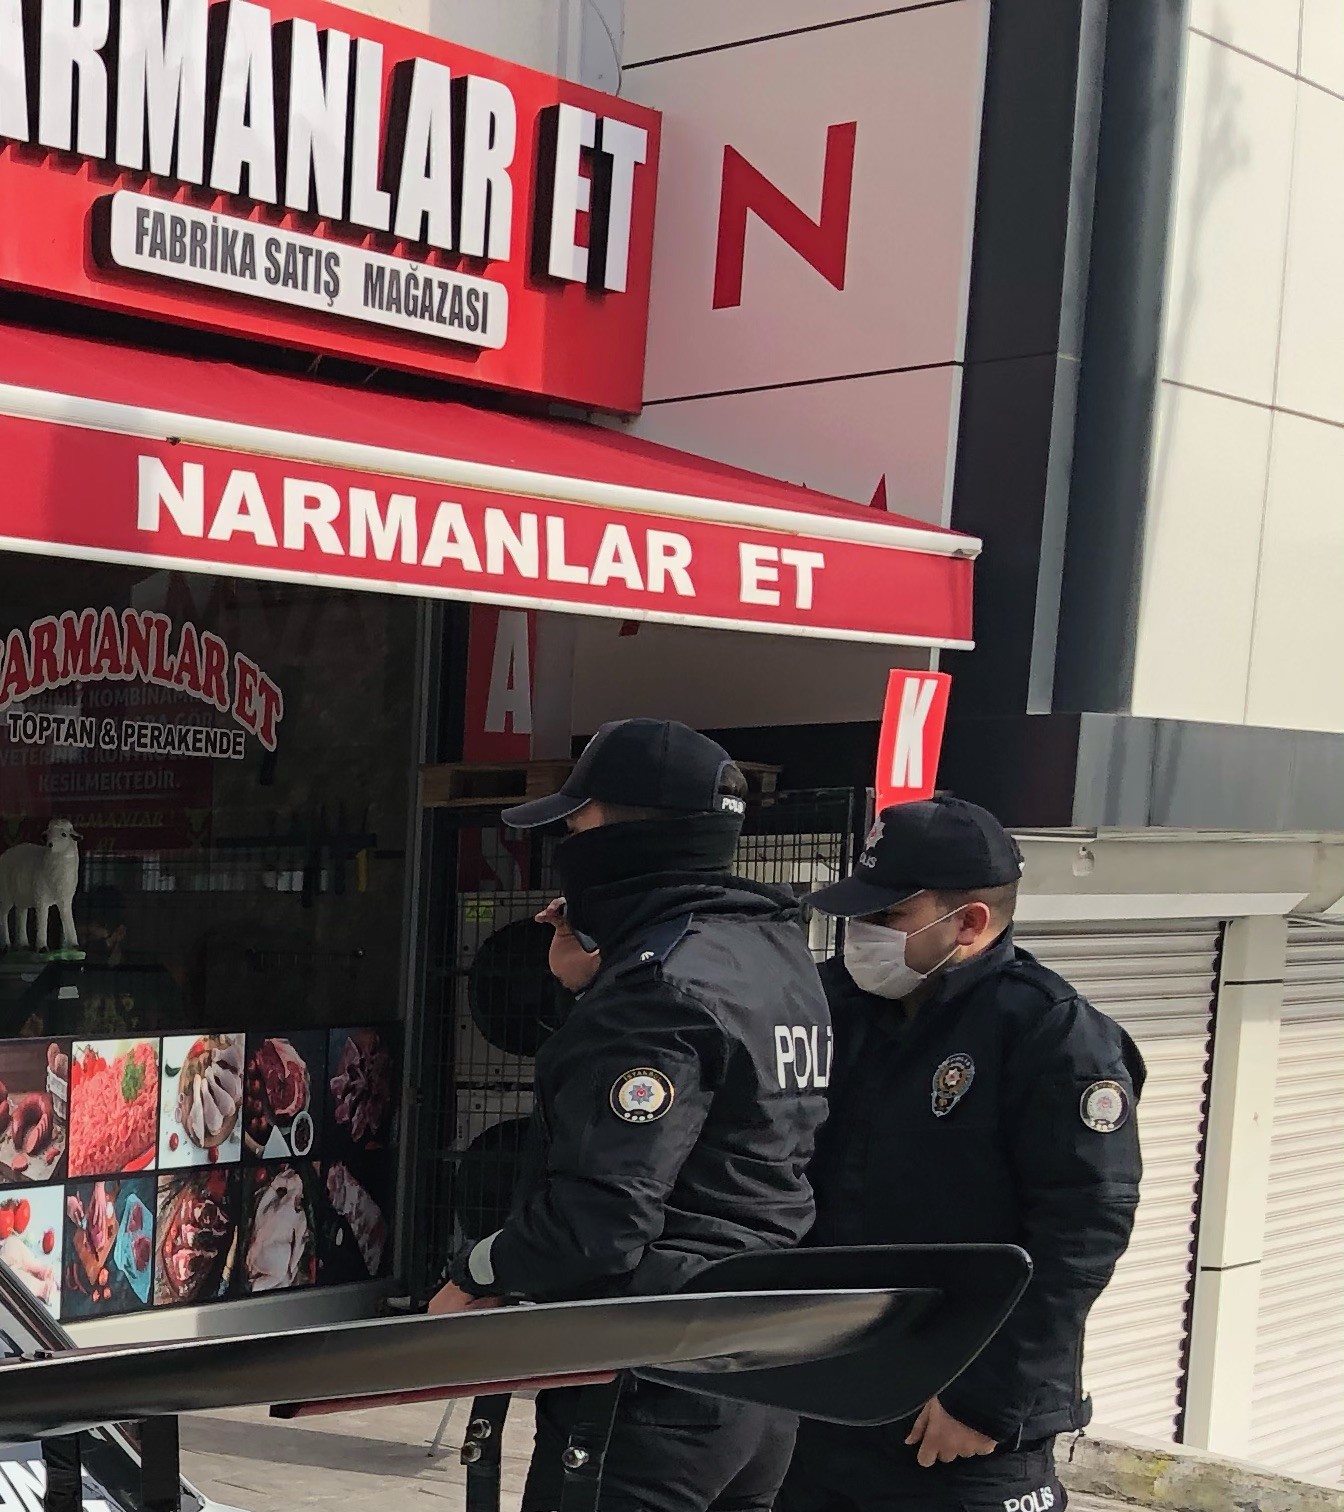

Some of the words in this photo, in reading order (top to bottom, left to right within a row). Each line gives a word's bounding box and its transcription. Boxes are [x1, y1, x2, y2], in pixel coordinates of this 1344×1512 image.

[547, 102, 650, 294] ET
[134, 206, 257, 282] FABRİKA
[263, 236, 341, 307] SATIŞ
[362, 262, 489, 335] MAĞAZASI
[137, 456, 696, 597] NARMANLAR
[738, 542, 826, 611] ET
[8, 712, 96, 748] TOPTAN
[100, 718, 118, 750] &
[121, 721, 246, 760] PERAKENDE
[232, 652, 284, 752] ET
